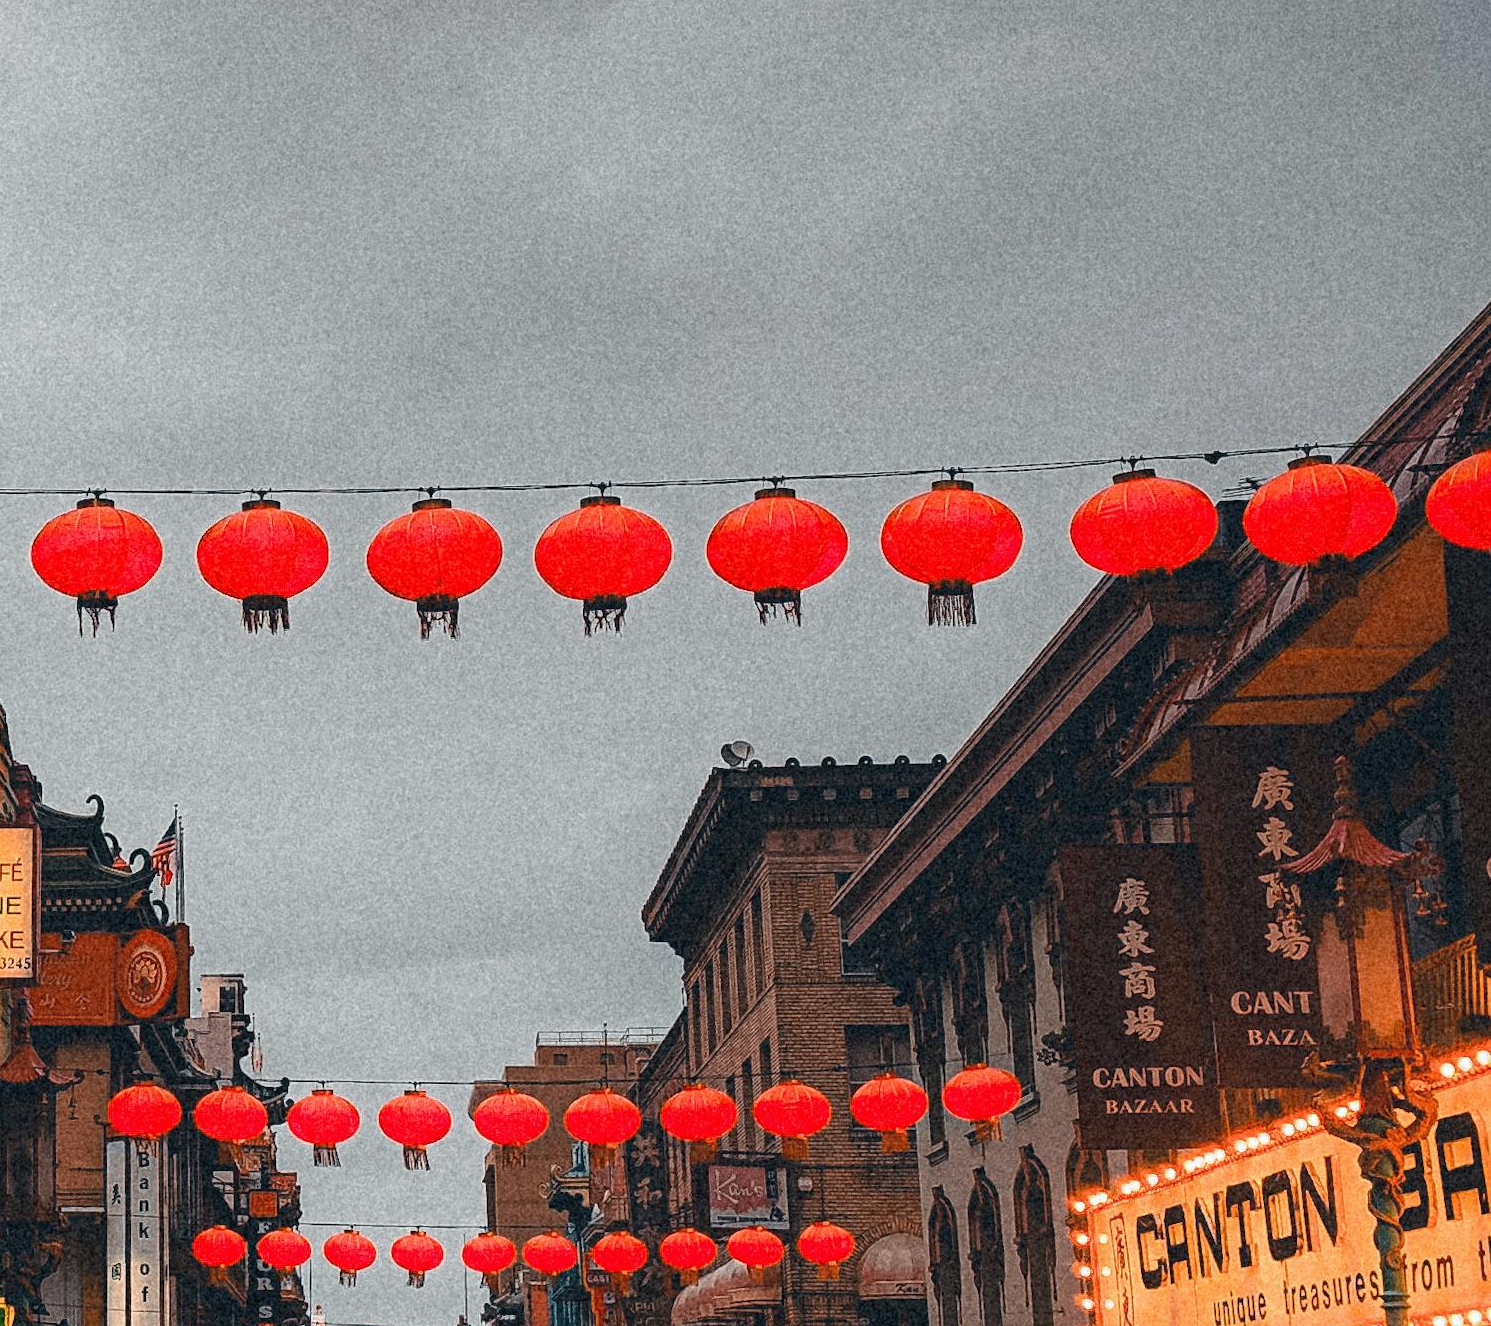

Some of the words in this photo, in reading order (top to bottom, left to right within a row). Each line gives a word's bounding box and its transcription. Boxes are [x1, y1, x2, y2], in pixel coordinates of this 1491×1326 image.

[1113, 878, 1164, 1042] 廣東商場
[1230, 990, 1314, 1016] CANT
[1247, 1028, 1318, 1046] BAZA
[1092, 1066, 1204, 1089] CANTON
[1105, 1099, 1195, 1115] BAZAAR
[138, 1151, 150, 1239] Bank
[714, 1169, 764, 1204] Kan's
[1136, 1156, 1341, 1290] CANTON
[139, 1262, 150, 1302] of
[1284, 1271, 1379, 1316] treasures
